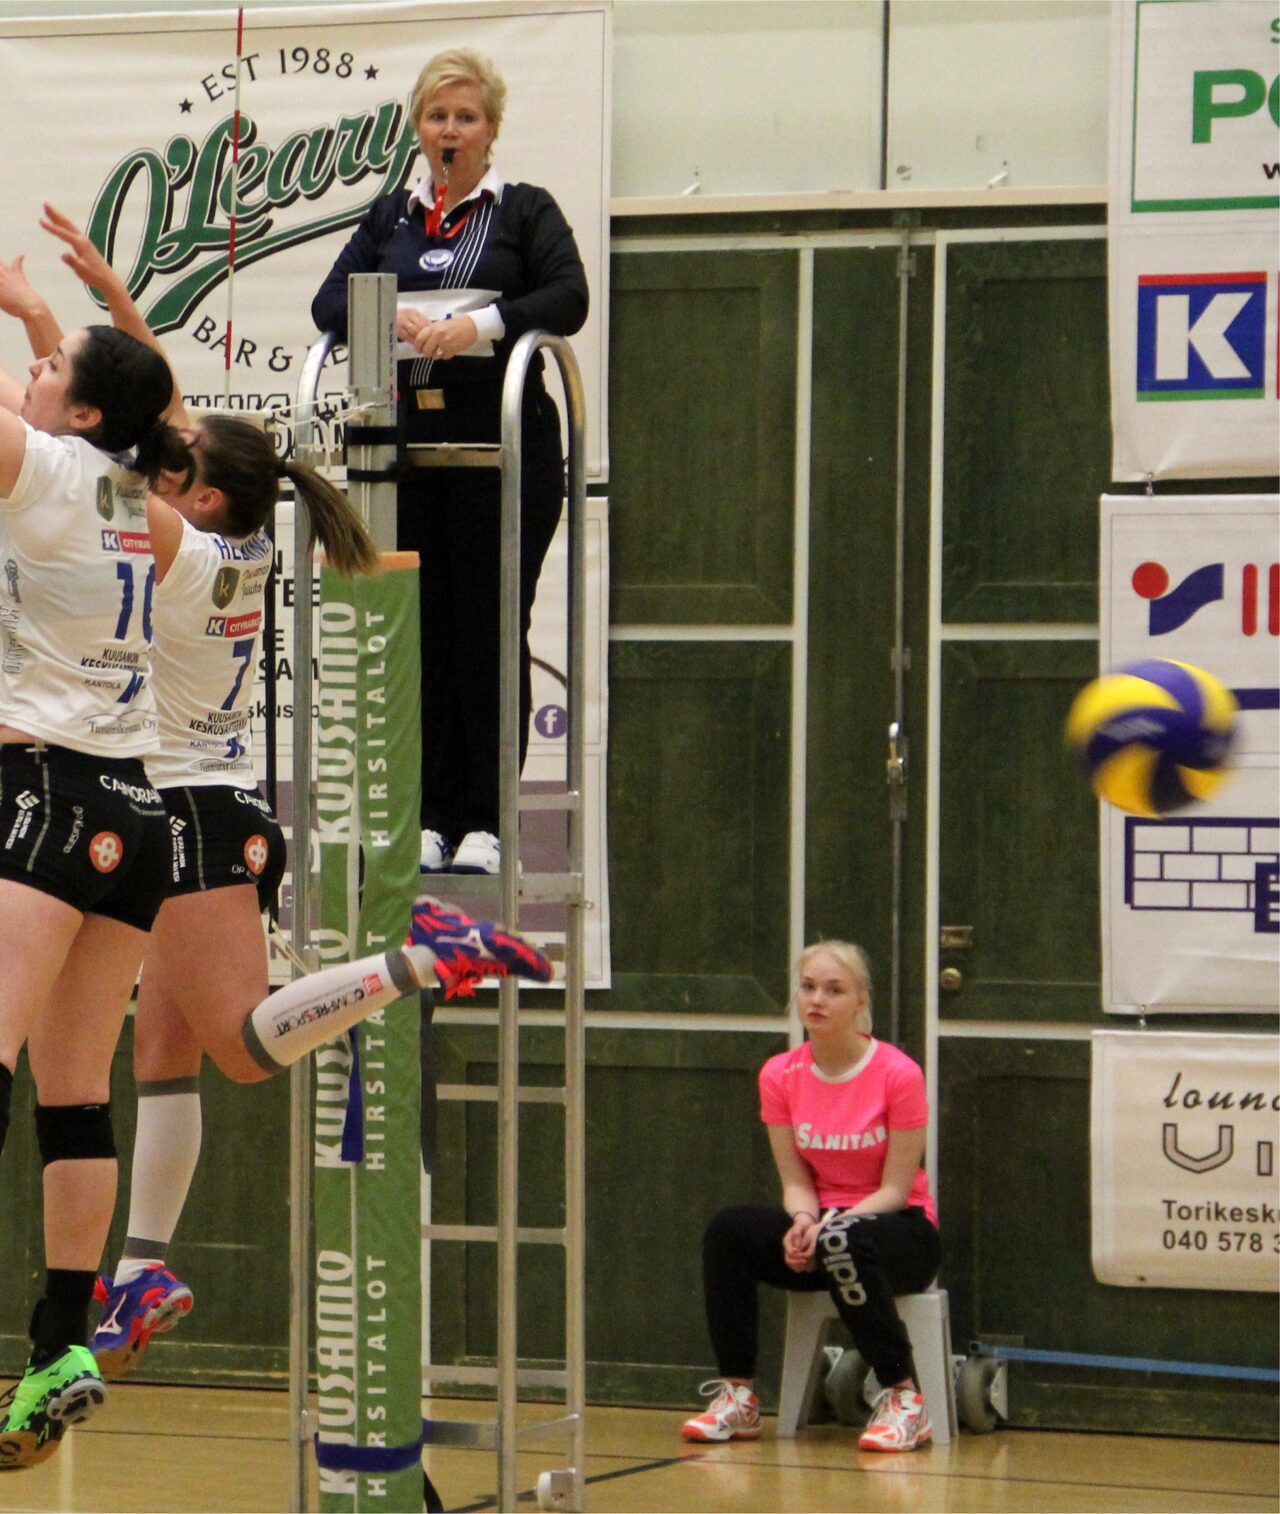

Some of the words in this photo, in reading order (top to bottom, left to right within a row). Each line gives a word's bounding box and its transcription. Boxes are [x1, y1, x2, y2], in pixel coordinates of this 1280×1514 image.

[201, 53, 260, 101] EST
[279, 46, 354, 79] 1988
[1192, 69, 1280, 144] P
[192, 316, 257, 367] BAR
[269, 346, 294, 372] &
[1155, 292, 1253, 380] K
[220, 638, 255, 710] 7
[319, 601, 357, 844] KUUSAMO
[366, 611, 390, 848] HIRSITALOT
[1163, 1230, 1207, 1250] 040
[1218, 1232, 1263, 1253] 578
[366, 1256, 388, 1497] HRSITALOT
